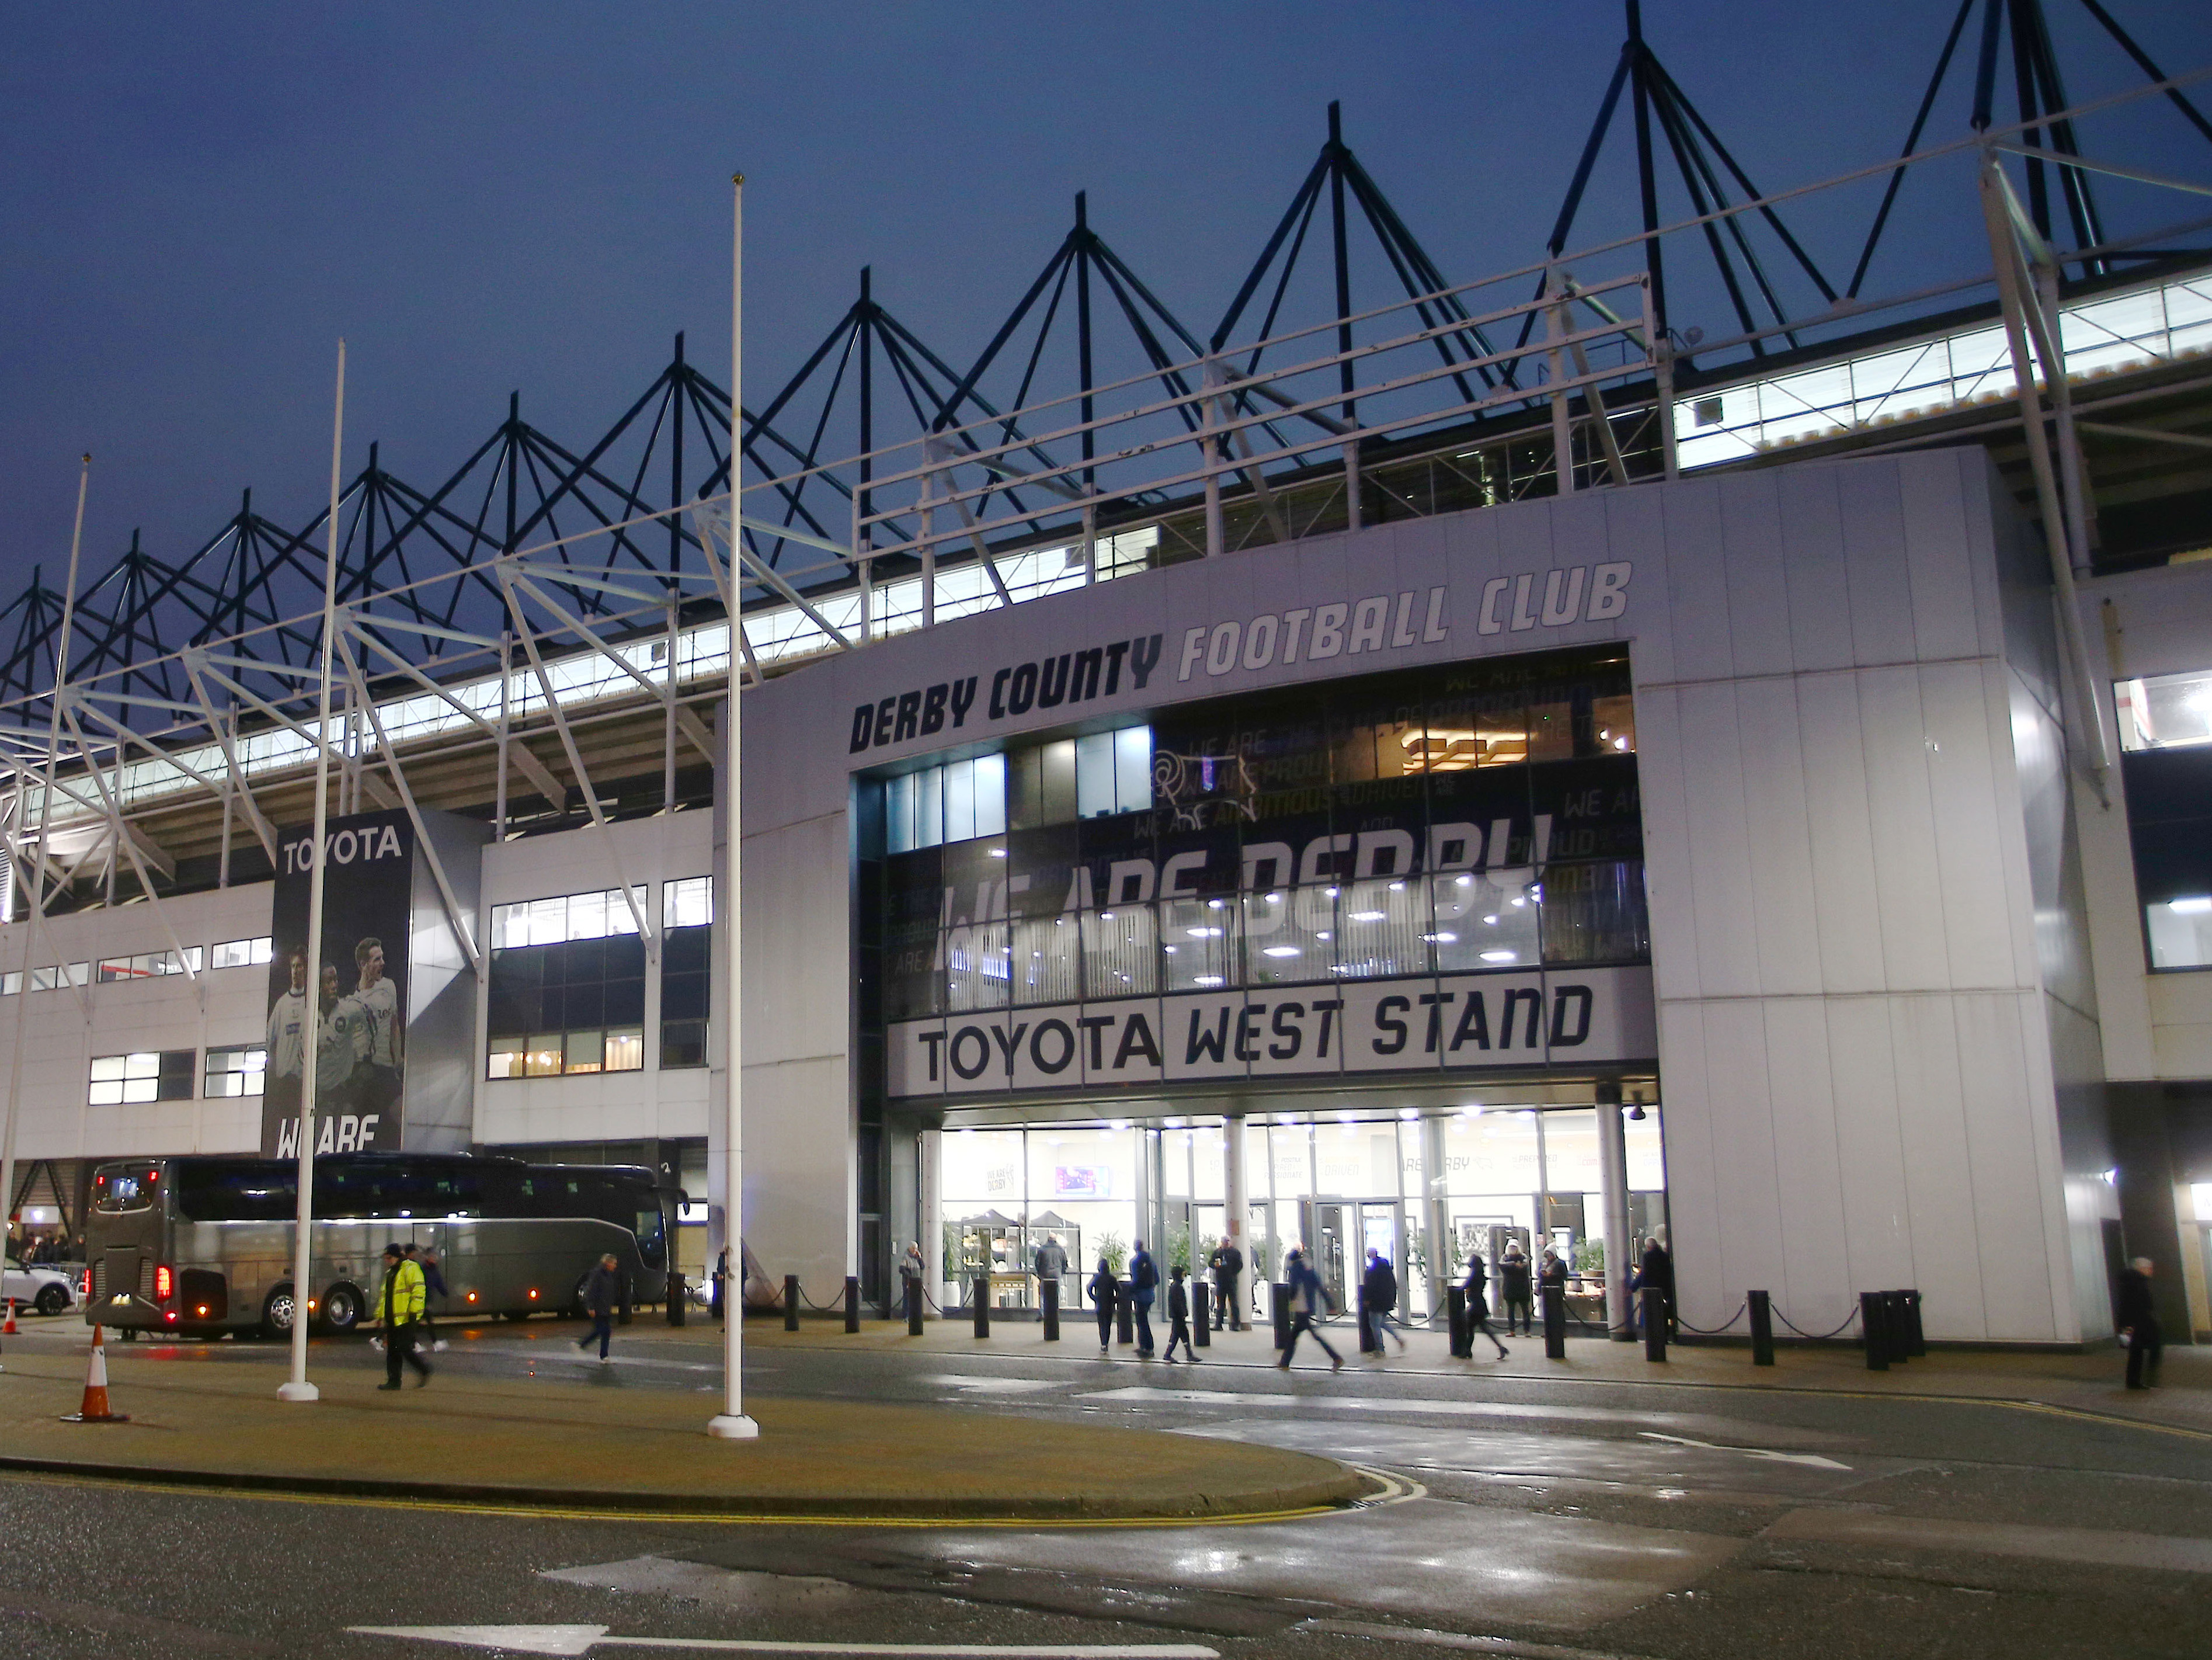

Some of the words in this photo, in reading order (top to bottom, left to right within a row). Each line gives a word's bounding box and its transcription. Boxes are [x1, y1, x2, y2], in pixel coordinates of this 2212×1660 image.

[850, 676, 978, 754] DERBY
[989, 634, 1163, 720] COUNTY
[1178, 585, 1449, 682] FOOTBALL
[1478, 561, 1633, 635] CLUB
[1564, 791, 1602, 819] WE
[934, 874, 1030, 972] WE
[1050, 850, 1208, 960] ARE
[1239, 814, 1552, 937] DERBY
[919, 1013, 1161, 1081] TOYOTA
[1185, 999, 1344, 1065] WEST
[1372, 985, 1593, 1055] STAND
[276, 1117, 301, 1159] W
[1324, 1165, 1359, 1176] DRIVEN
[1518, 1154, 1557, 1163] PREPED
[988, 1179, 1006, 1192] DERBY
[1264, 1171, 1303, 1179] PSIONATE
